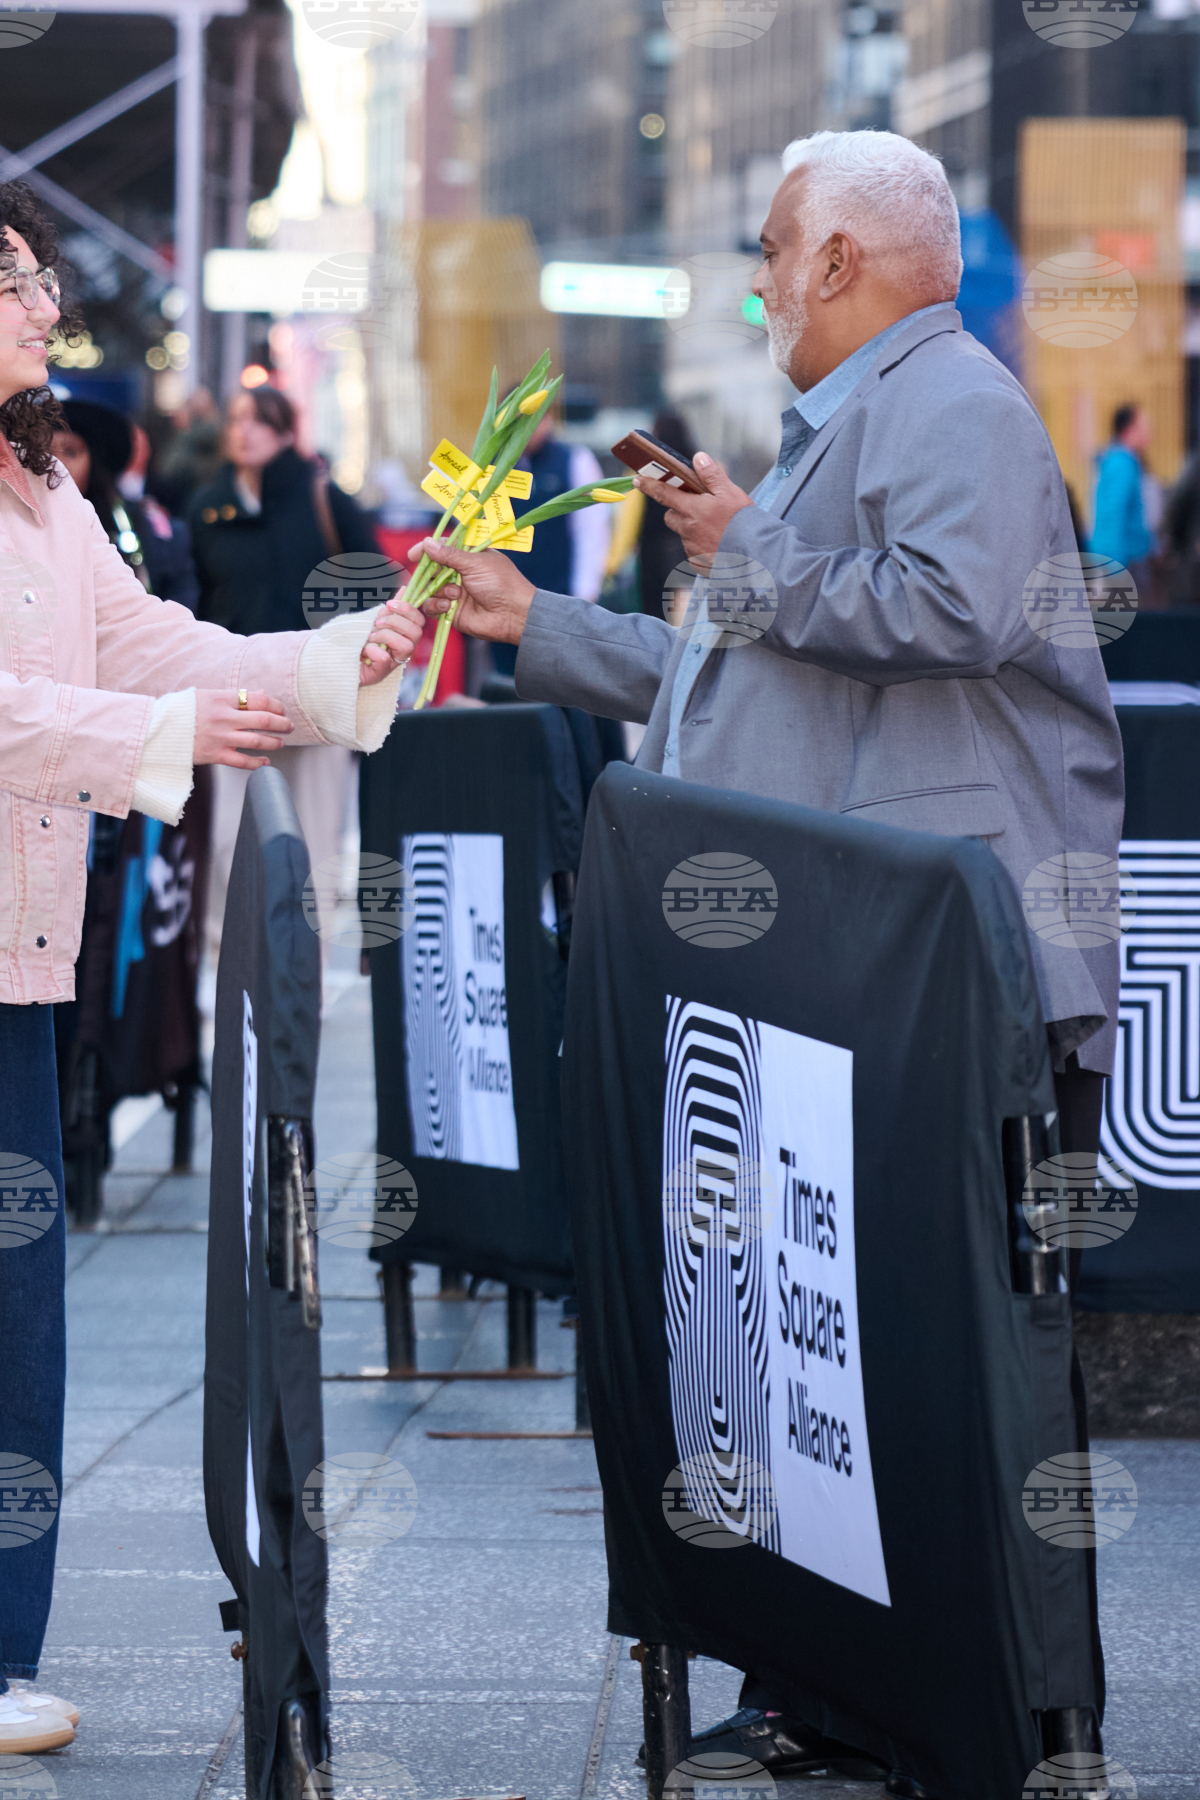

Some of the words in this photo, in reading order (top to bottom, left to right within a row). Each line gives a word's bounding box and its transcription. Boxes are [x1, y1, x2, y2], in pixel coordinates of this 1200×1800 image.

[464, 969, 509, 1039] Square
[779, 1146, 838, 1260] Times
[778, 1250, 847, 1371] Square
[788, 1377, 853, 1478] Alliance
